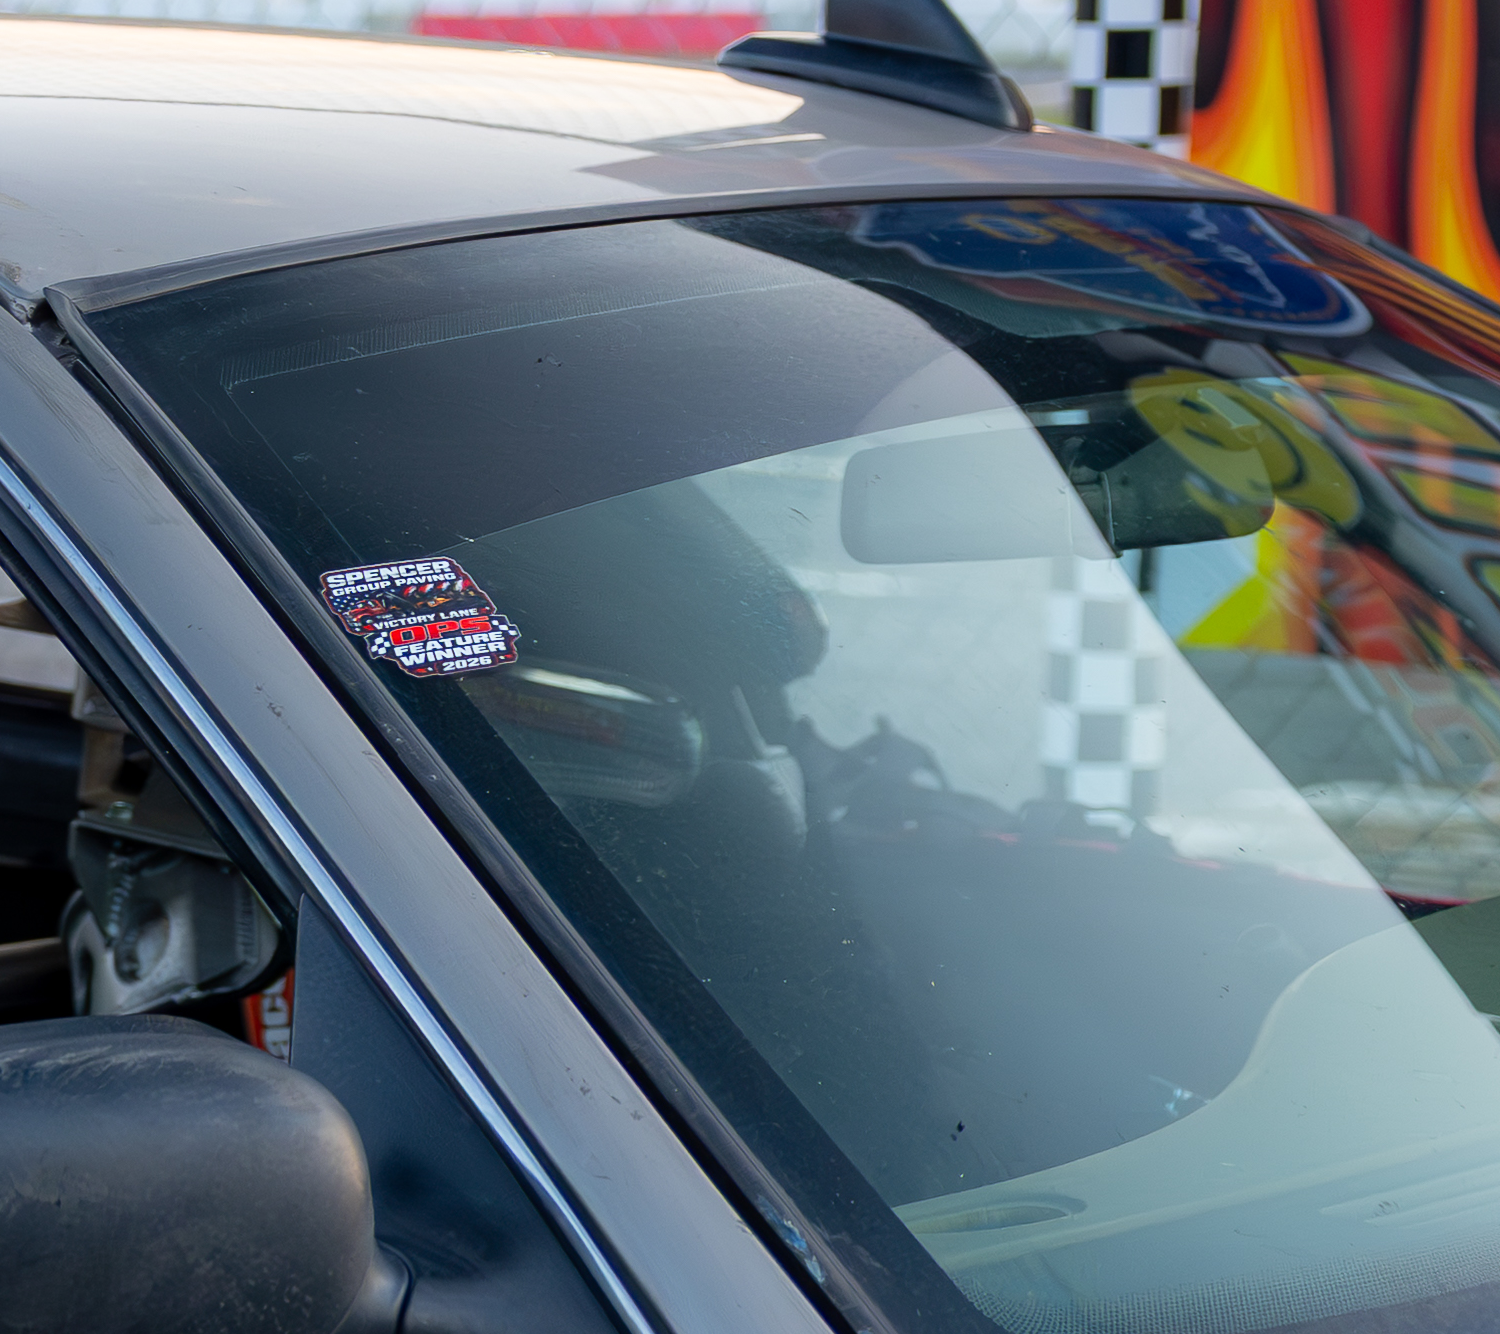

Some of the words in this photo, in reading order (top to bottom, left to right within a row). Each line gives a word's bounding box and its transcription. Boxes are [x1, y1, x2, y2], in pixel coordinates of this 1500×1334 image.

[326, 560, 451, 588] SPENCER
[332, 580, 391, 597] GROUP
[395, 572, 457, 586] PAVING
[373, 612, 436, 630] VICTORY
[441, 608, 479, 620] LANE
[389, 616, 493, 646] OPS
[393, 631, 505, 657] FEATURE
[399, 642, 506, 667] WINNER
[442, 656, 493, 672] 2026
